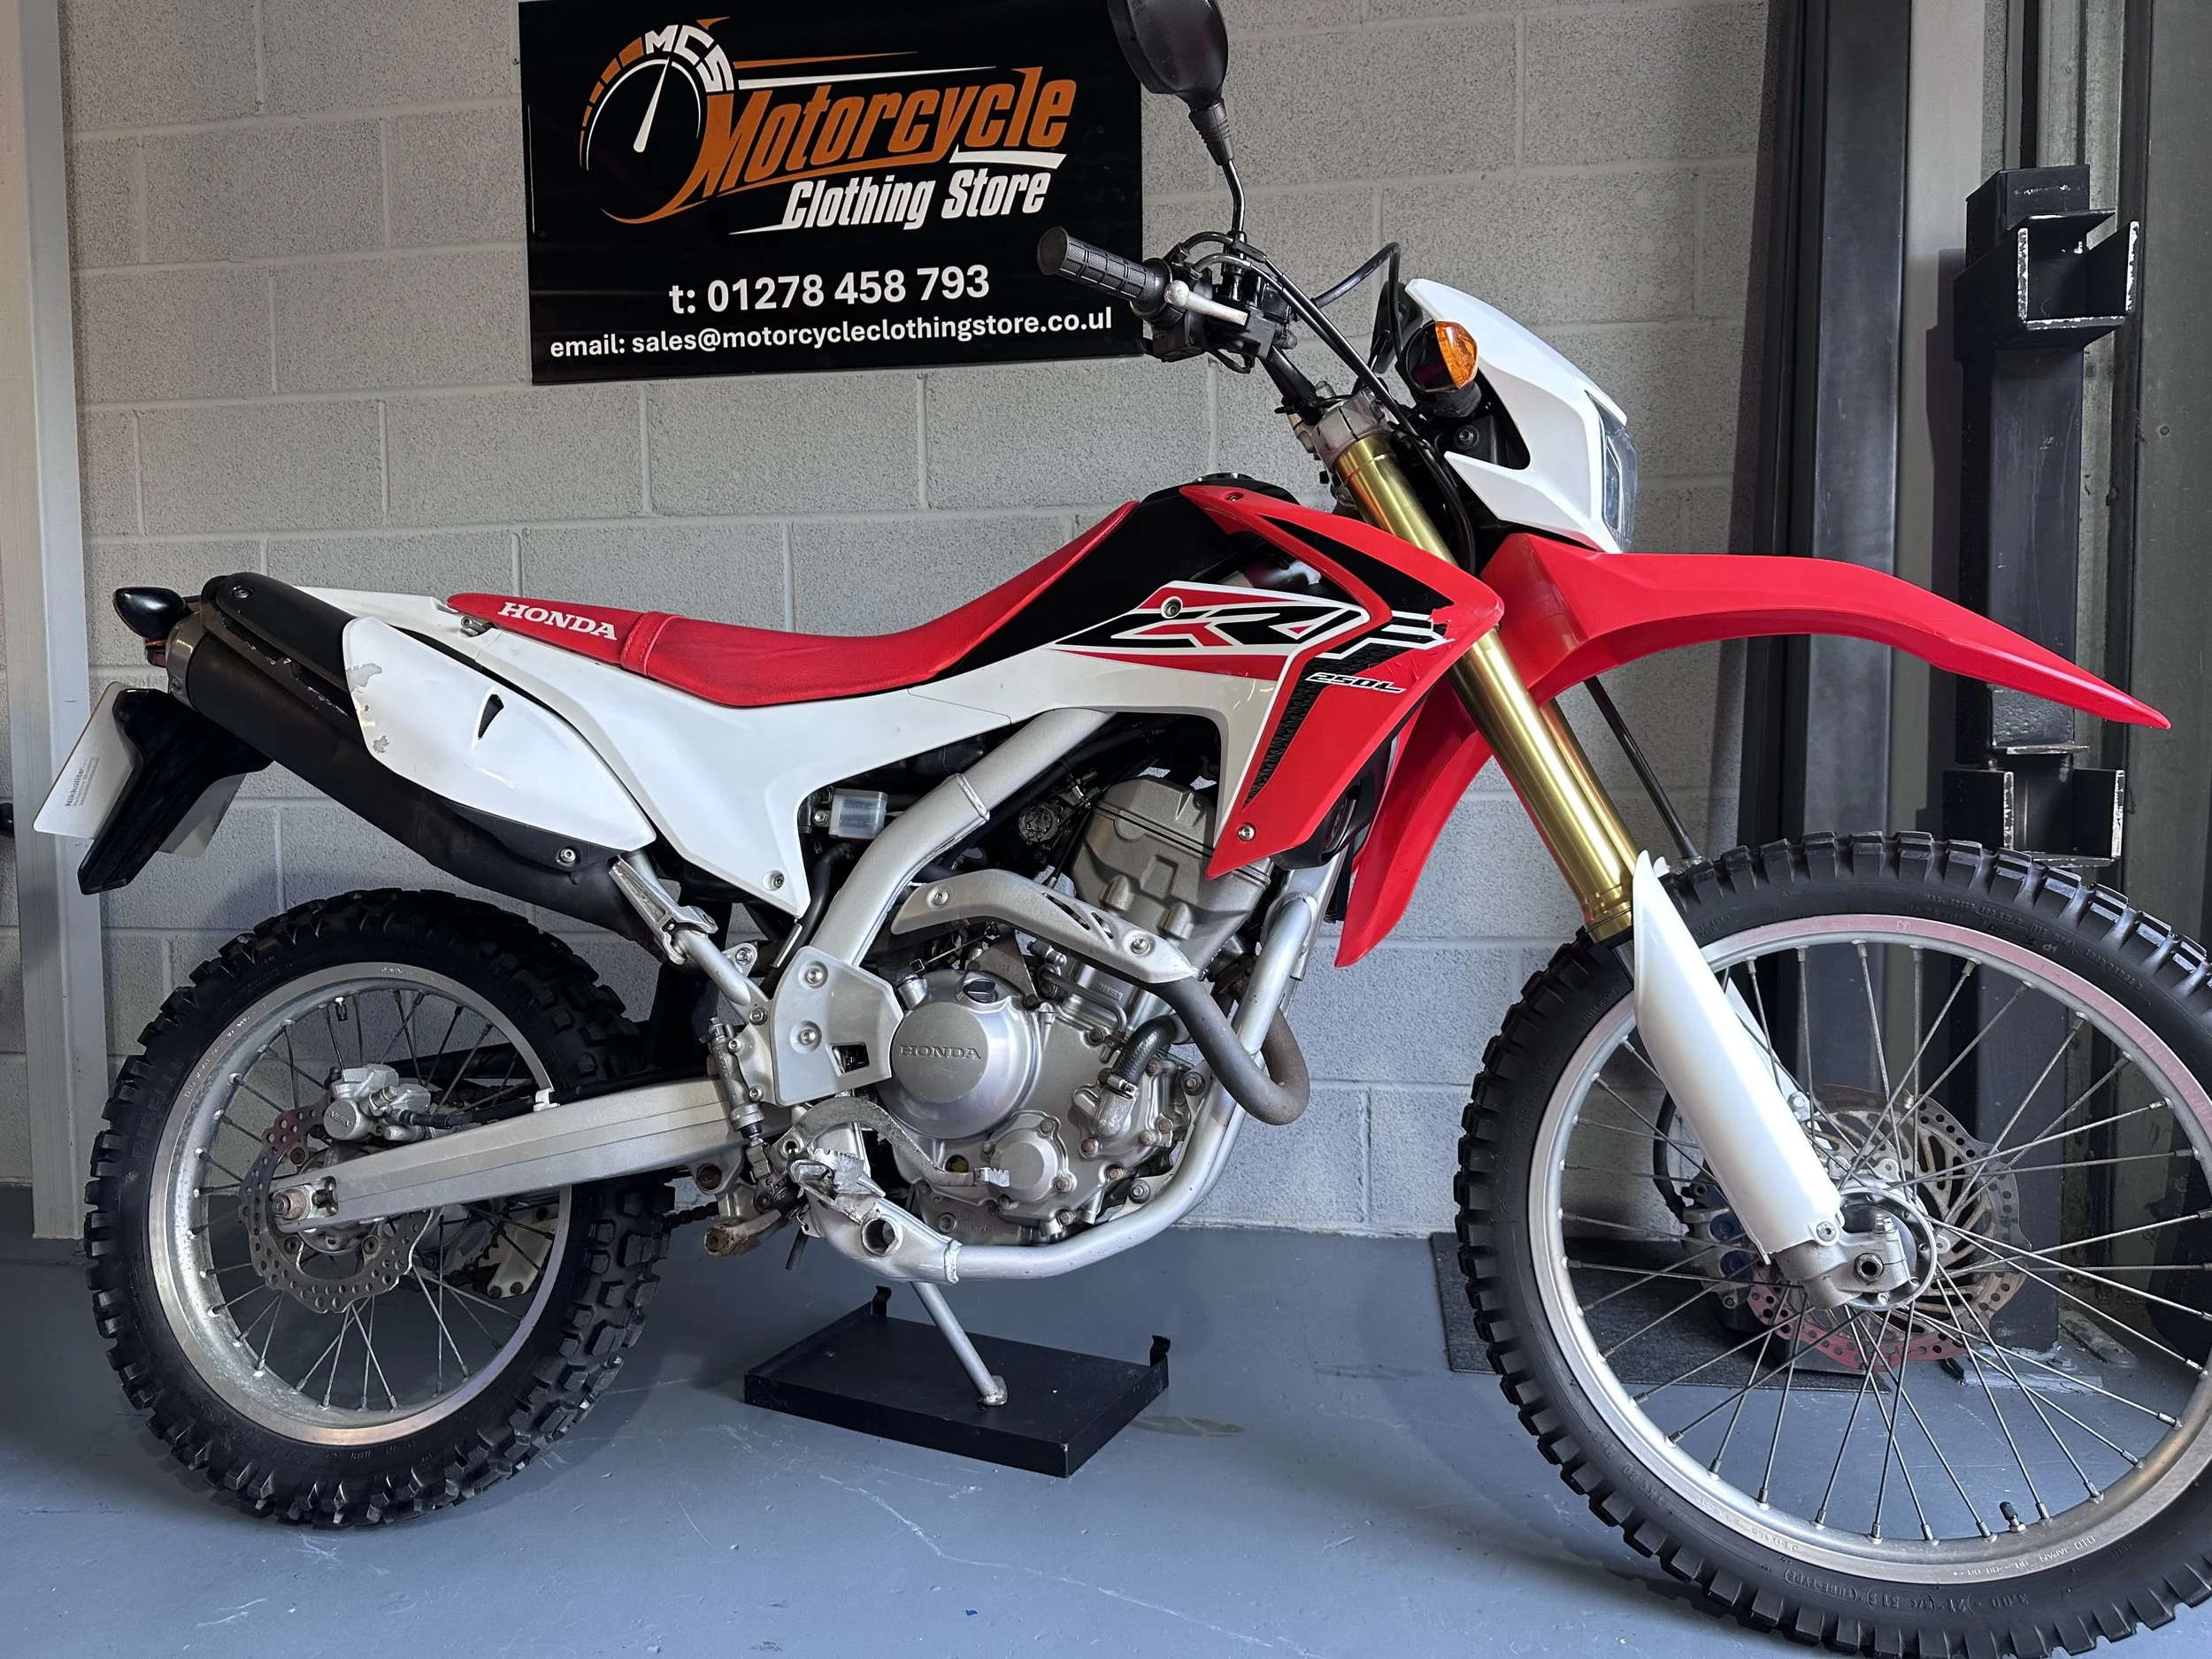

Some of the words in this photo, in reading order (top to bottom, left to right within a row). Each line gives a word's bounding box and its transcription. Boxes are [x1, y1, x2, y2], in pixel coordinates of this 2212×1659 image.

[644, 24, 734, 93] MCS
[692, 65, 1077, 198] Motorcycle
[782, 174, 936, 232] Clothing
[941, 167, 1051, 220] Store
[669, 284, 696, 314] t:
[707, 273, 824, 313] 01278
[833, 269, 906, 305] 458
[916, 264, 989, 302] 793
[549, 333, 626, 357] email:
[497, 602, 618, 641] HONDA
[1305, 672, 1407, 695] 250L
[899, 1044, 982, 1060] HONDA
[2039, 1547, 2071, 1563] JAPAN
